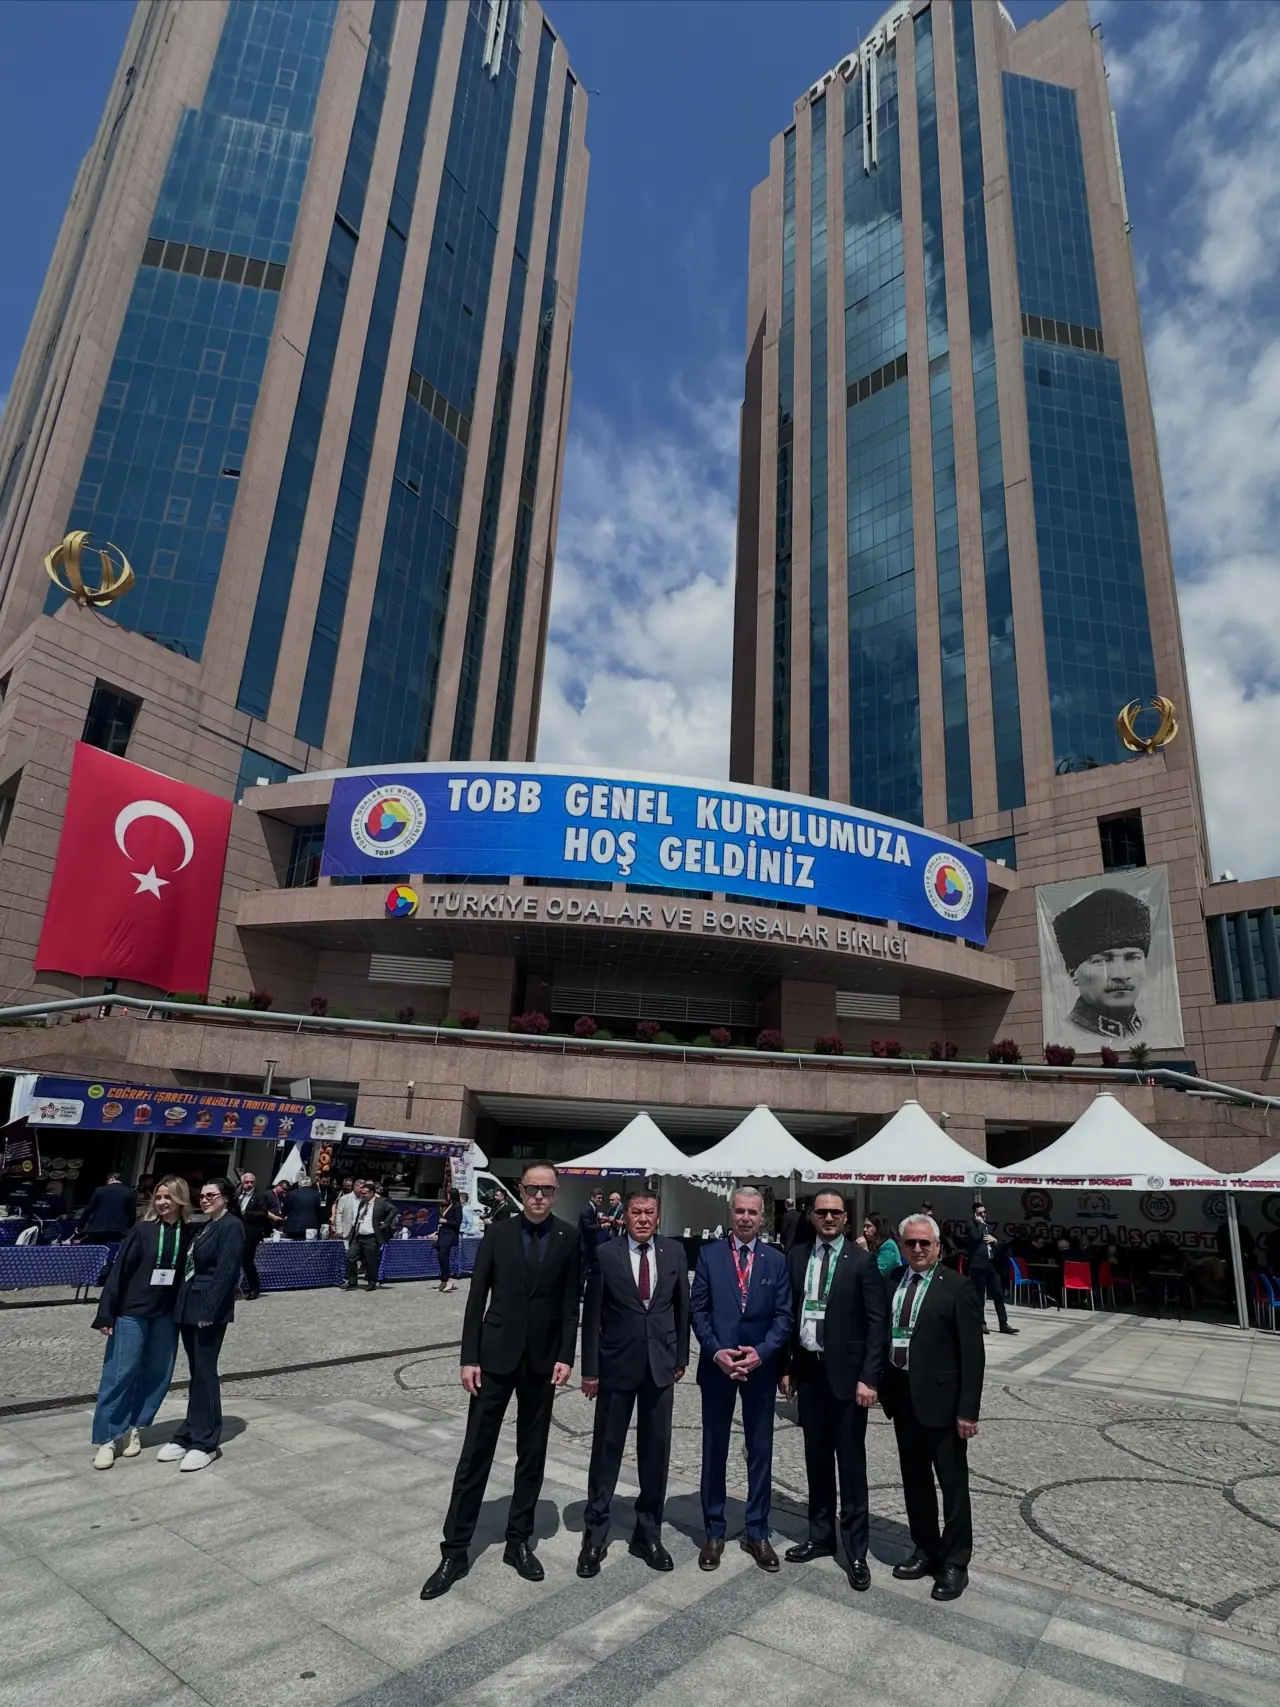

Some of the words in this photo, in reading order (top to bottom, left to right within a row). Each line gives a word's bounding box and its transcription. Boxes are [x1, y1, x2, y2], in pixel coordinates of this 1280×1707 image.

[447, 778, 542, 813] TOBB
[564, 782, 673, 825] GENEL
[696, 795, 912, 867] KURULUMUZA
[563, 826, 637, 876] HOŞ
[659, 836, 816, 889] GELDİNİZ
[430, 891, 538, 914] TÜRKİYE
[546, 896, 652, 922] ODALAR
[662, 905, 692, 924] VE
[702, 909, 829, 942] BORSALAR
[837, 926, 909, 957] BİRLİĞİ
